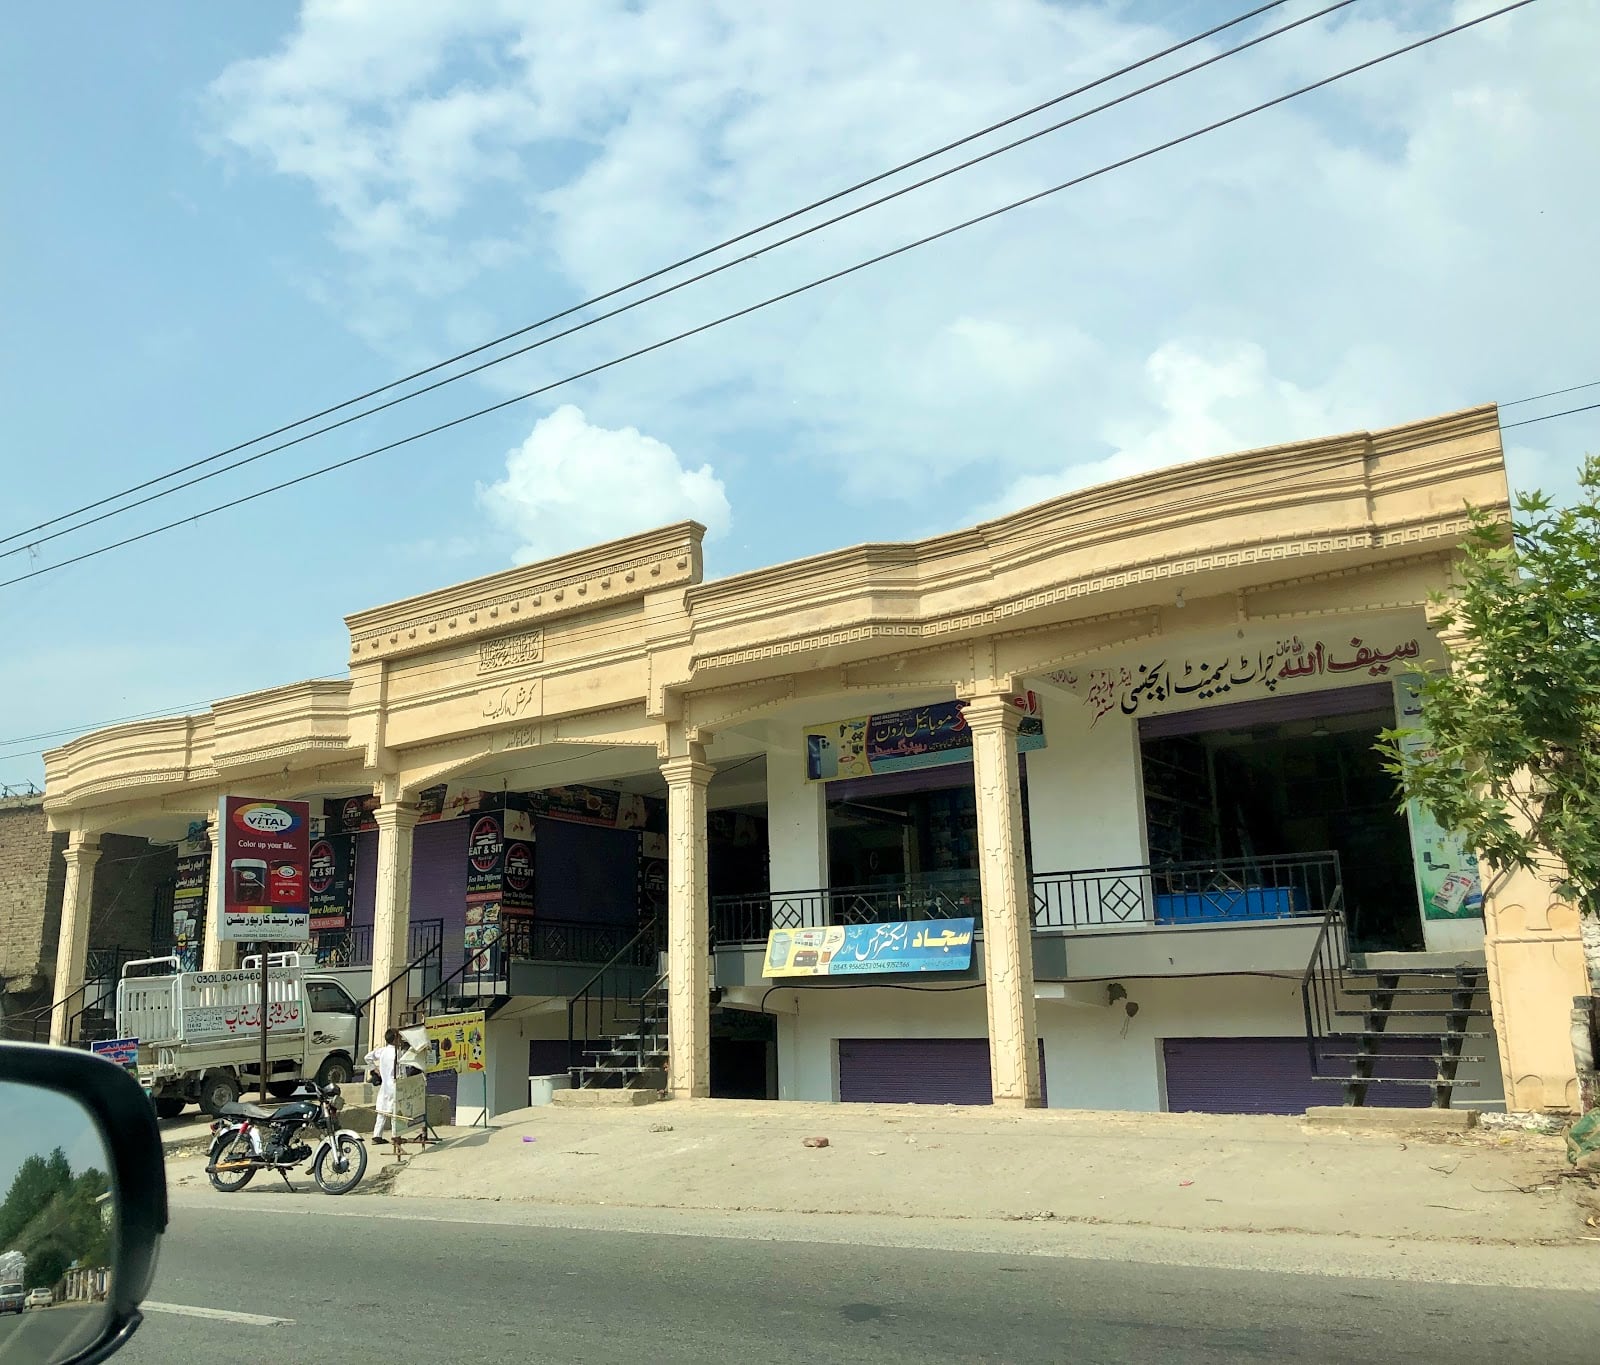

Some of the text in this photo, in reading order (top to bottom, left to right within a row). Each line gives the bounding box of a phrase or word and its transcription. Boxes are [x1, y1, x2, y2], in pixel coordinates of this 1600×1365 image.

[1327, 636, 1420, 677] سیف
[238, 840, 257, 849] Color
[258, 841, 266, 850] up
[267, 842, 282, 850] your
[468, 847, 482, 856] EAT
[491, 843, 503, 853] SIT
[504, 866, 516, 875] EAT
[323, 904, 345, 914] Delivery
[911, 927, 971, 953] سجاد
